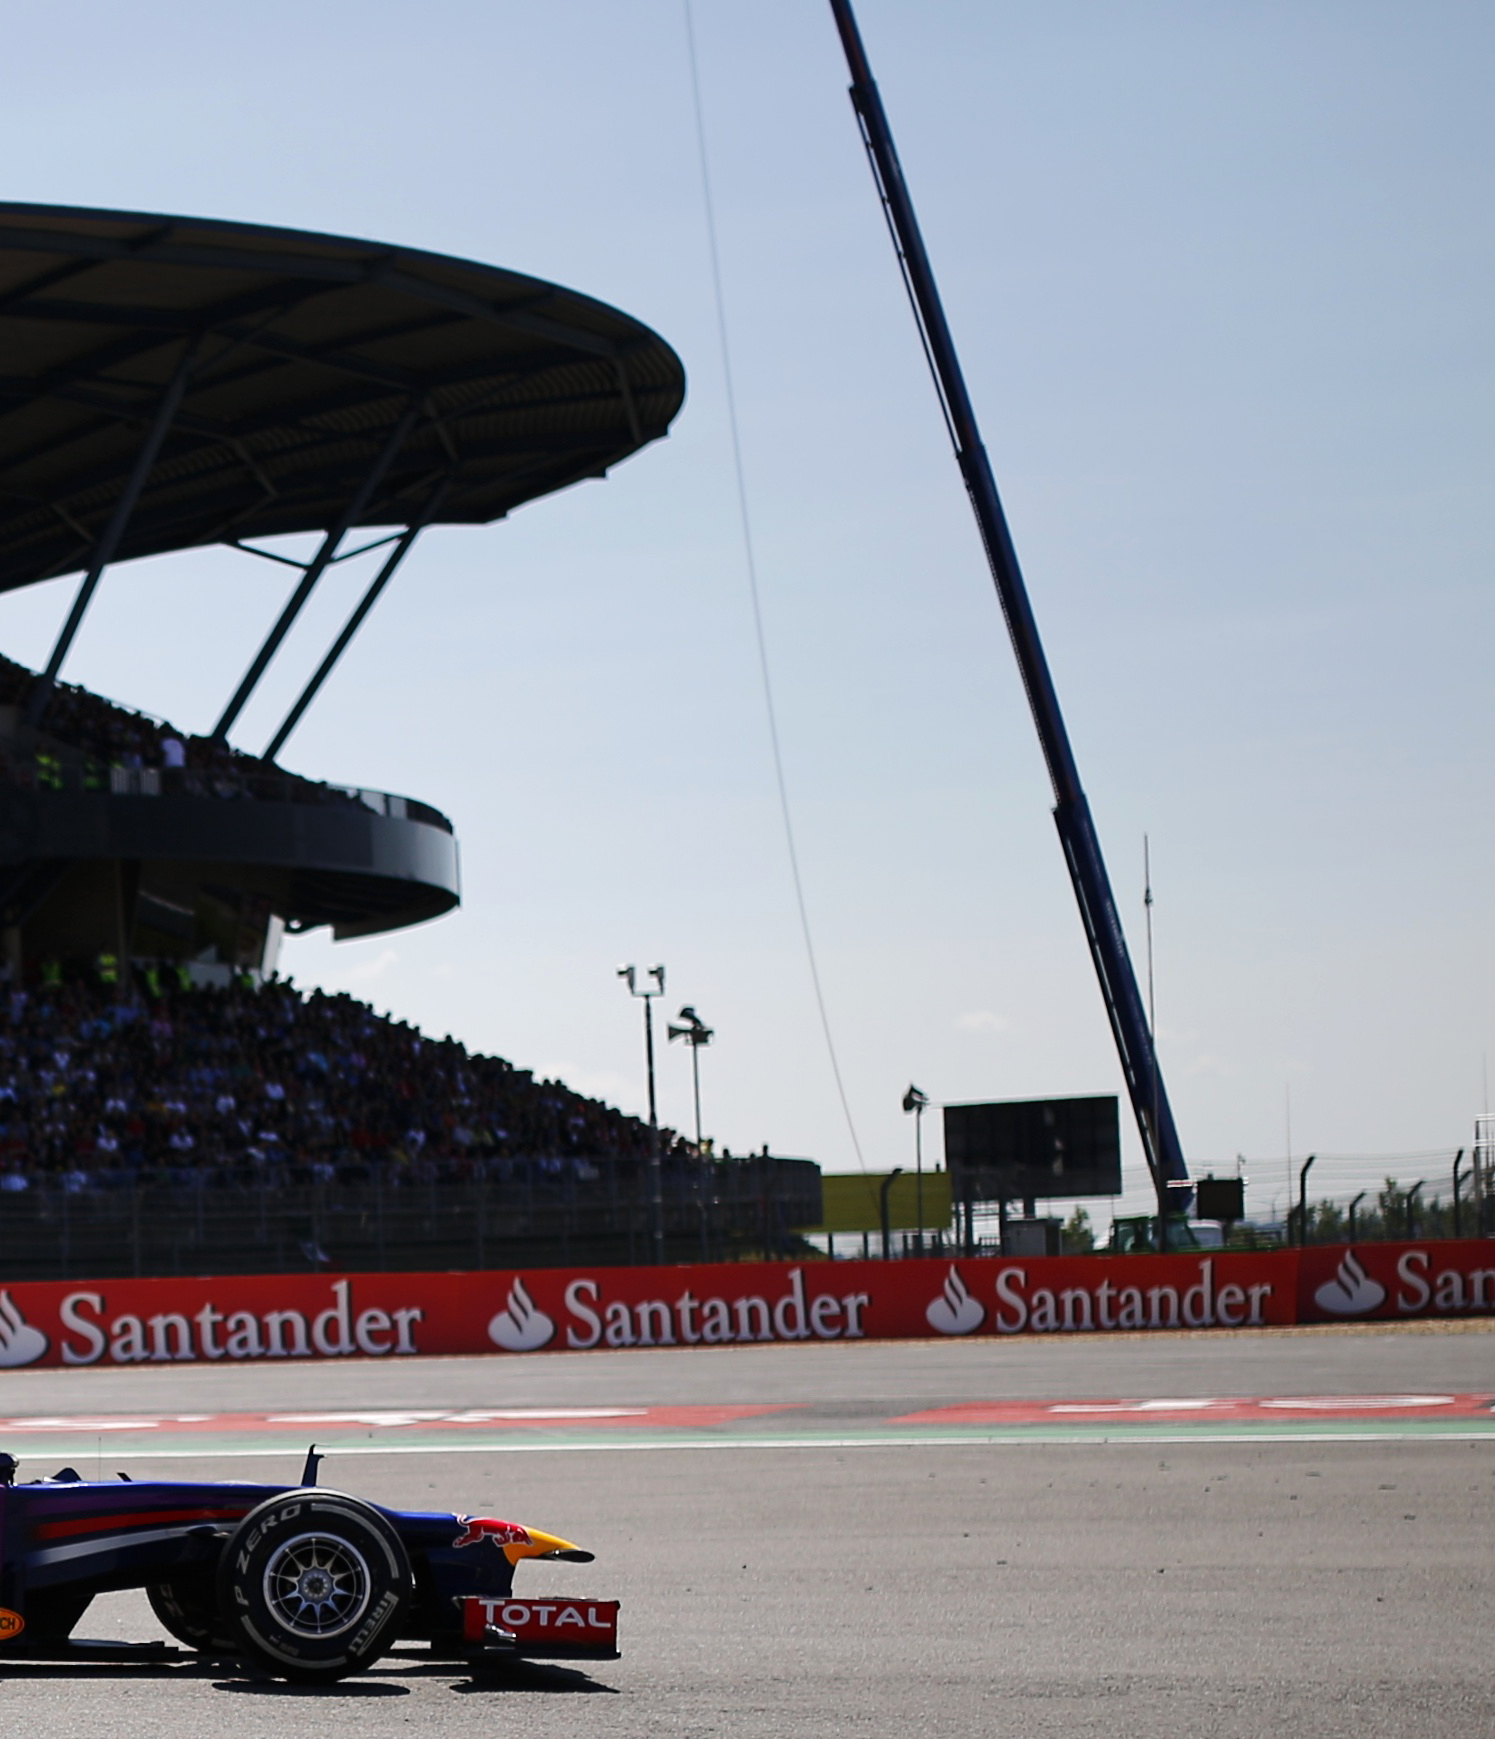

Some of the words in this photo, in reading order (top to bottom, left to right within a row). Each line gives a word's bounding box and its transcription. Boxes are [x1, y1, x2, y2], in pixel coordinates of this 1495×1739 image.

[60, 1279, 421, 1365] Santander
[565, 1268, 868, 1349] Santander
[995, 1259, 1272, 1333] Santander
[236, 1504, 302, 1575] ZERO
[234, 1585, 250, 1607] P
[348, 1590, 400, 1657] PIRELLI
[479, 1600, 611, 1628] TOTAL
